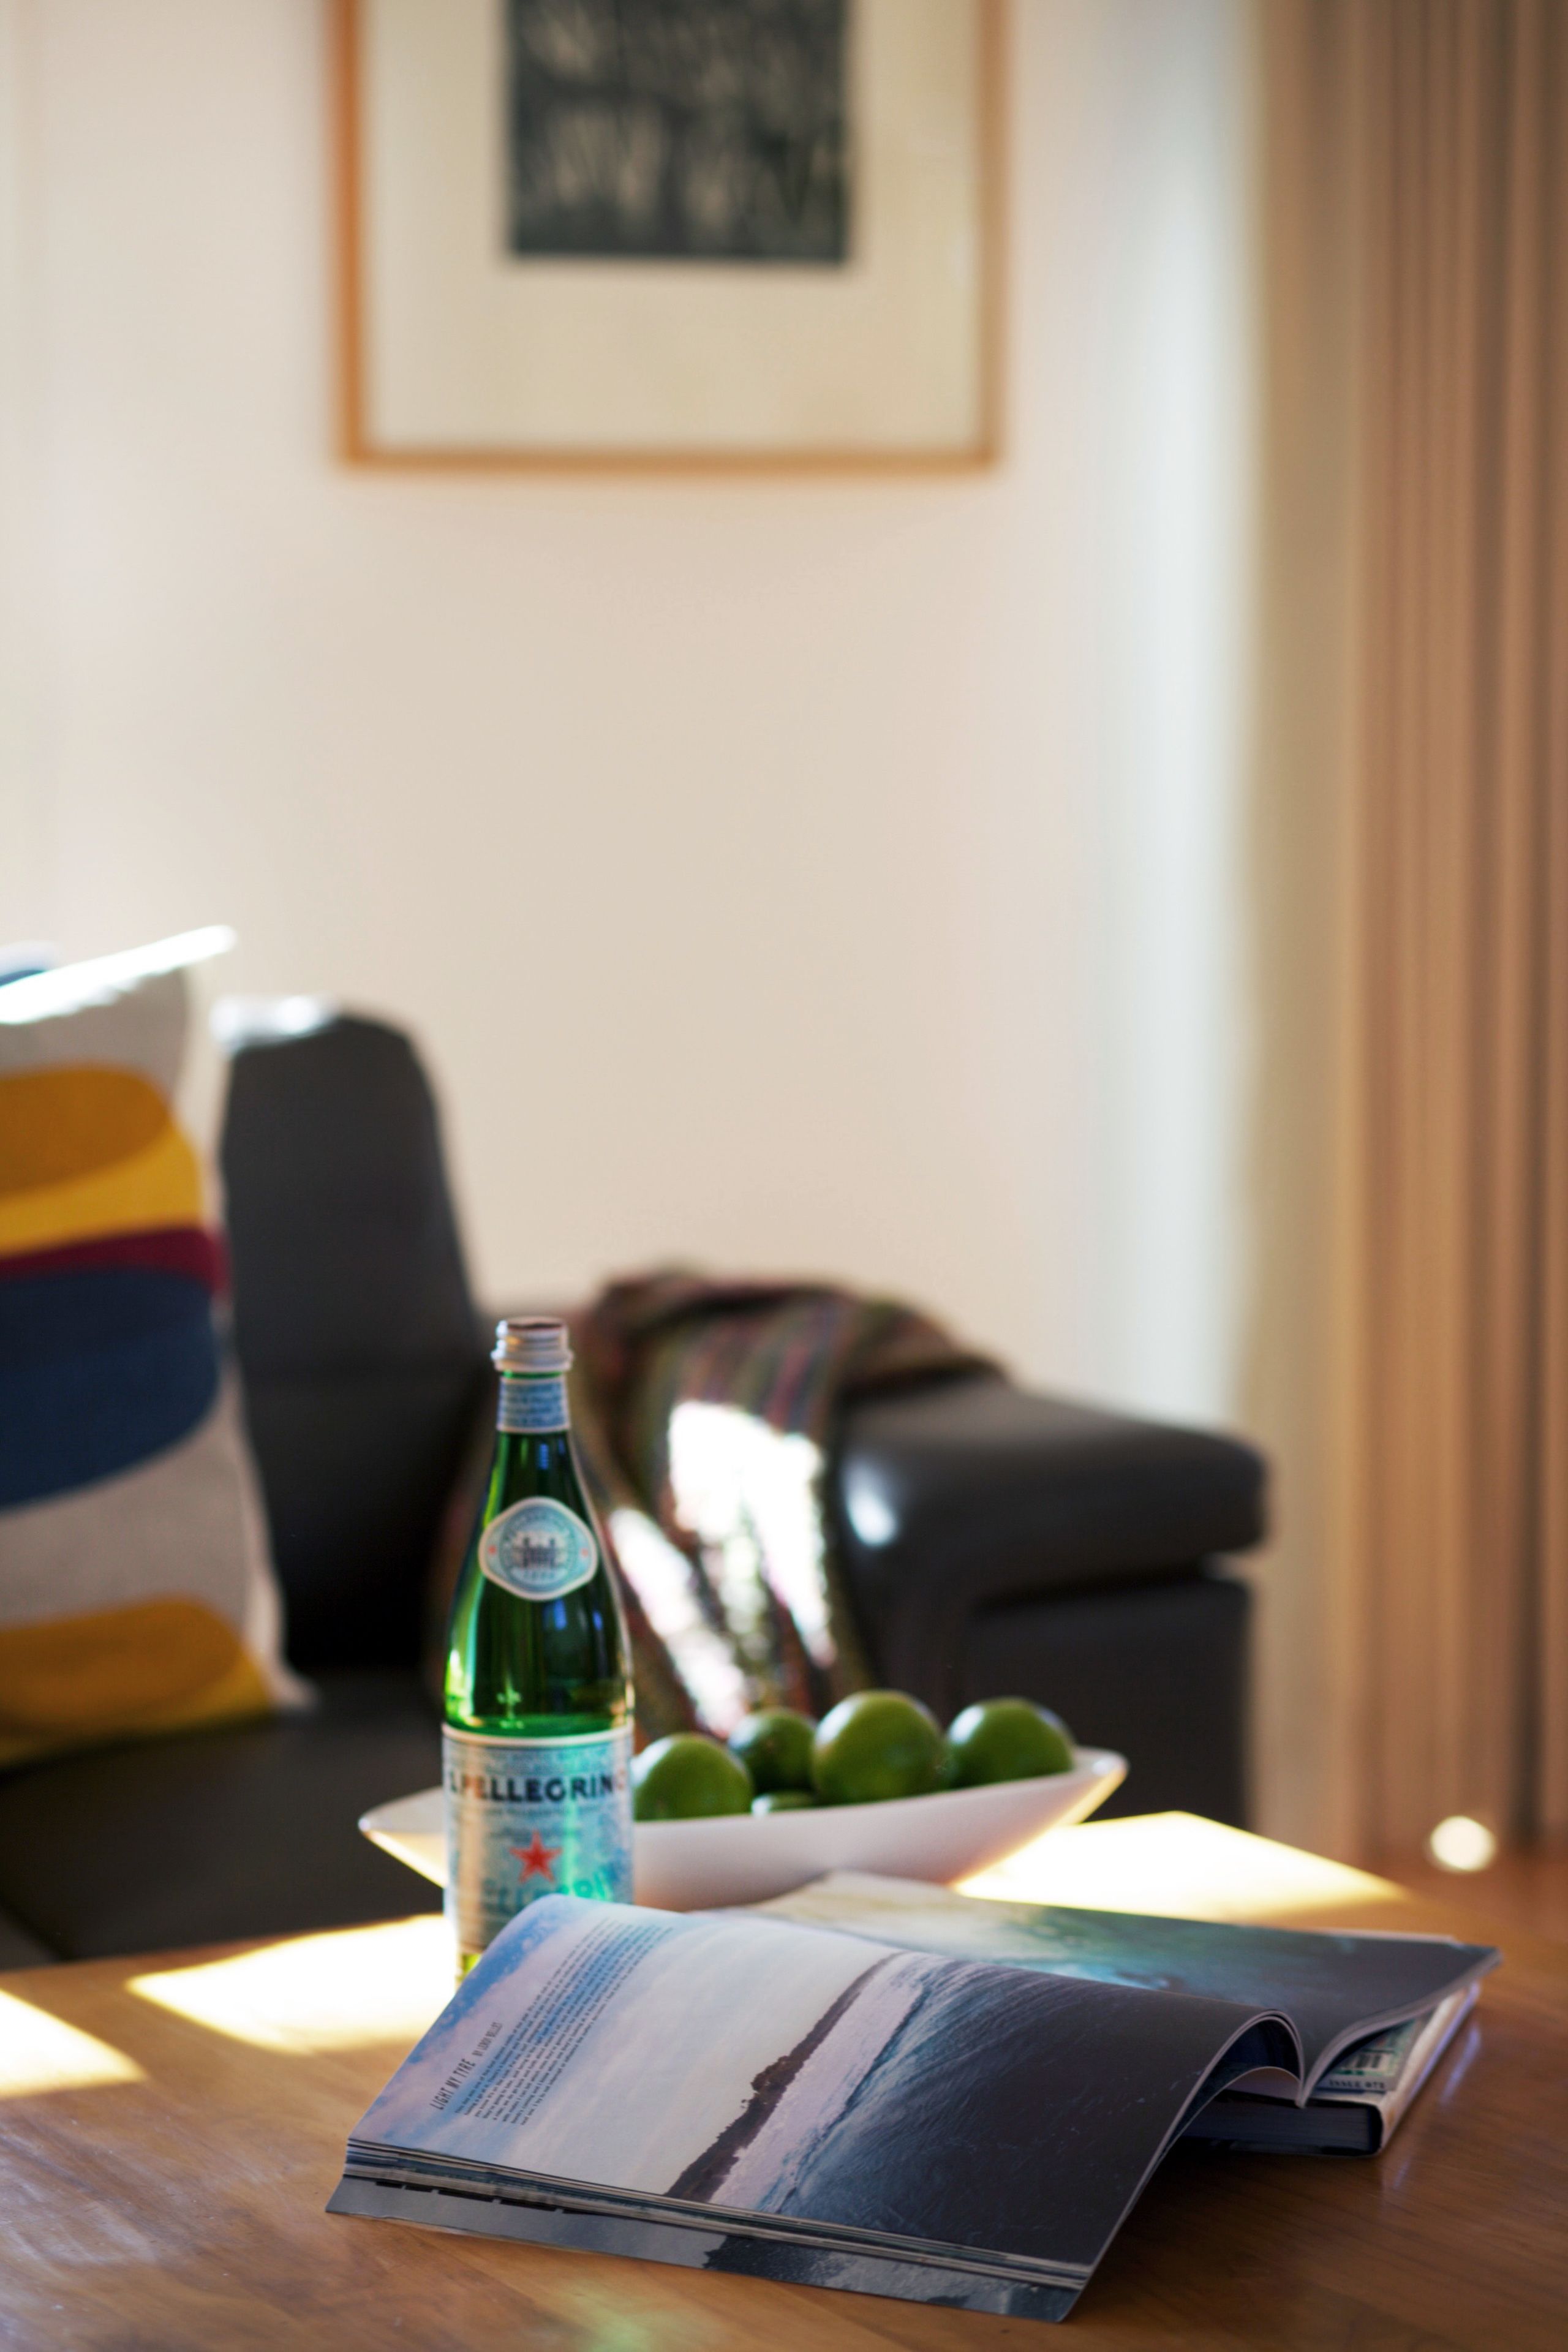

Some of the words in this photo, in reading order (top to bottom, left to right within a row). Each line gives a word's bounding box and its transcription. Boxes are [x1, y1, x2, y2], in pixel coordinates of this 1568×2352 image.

[429, 2087, 454, 2110] LIGHT
[445, 2076, 461, 2089] MY
[453, 2059, 476, 2078] TYRE
